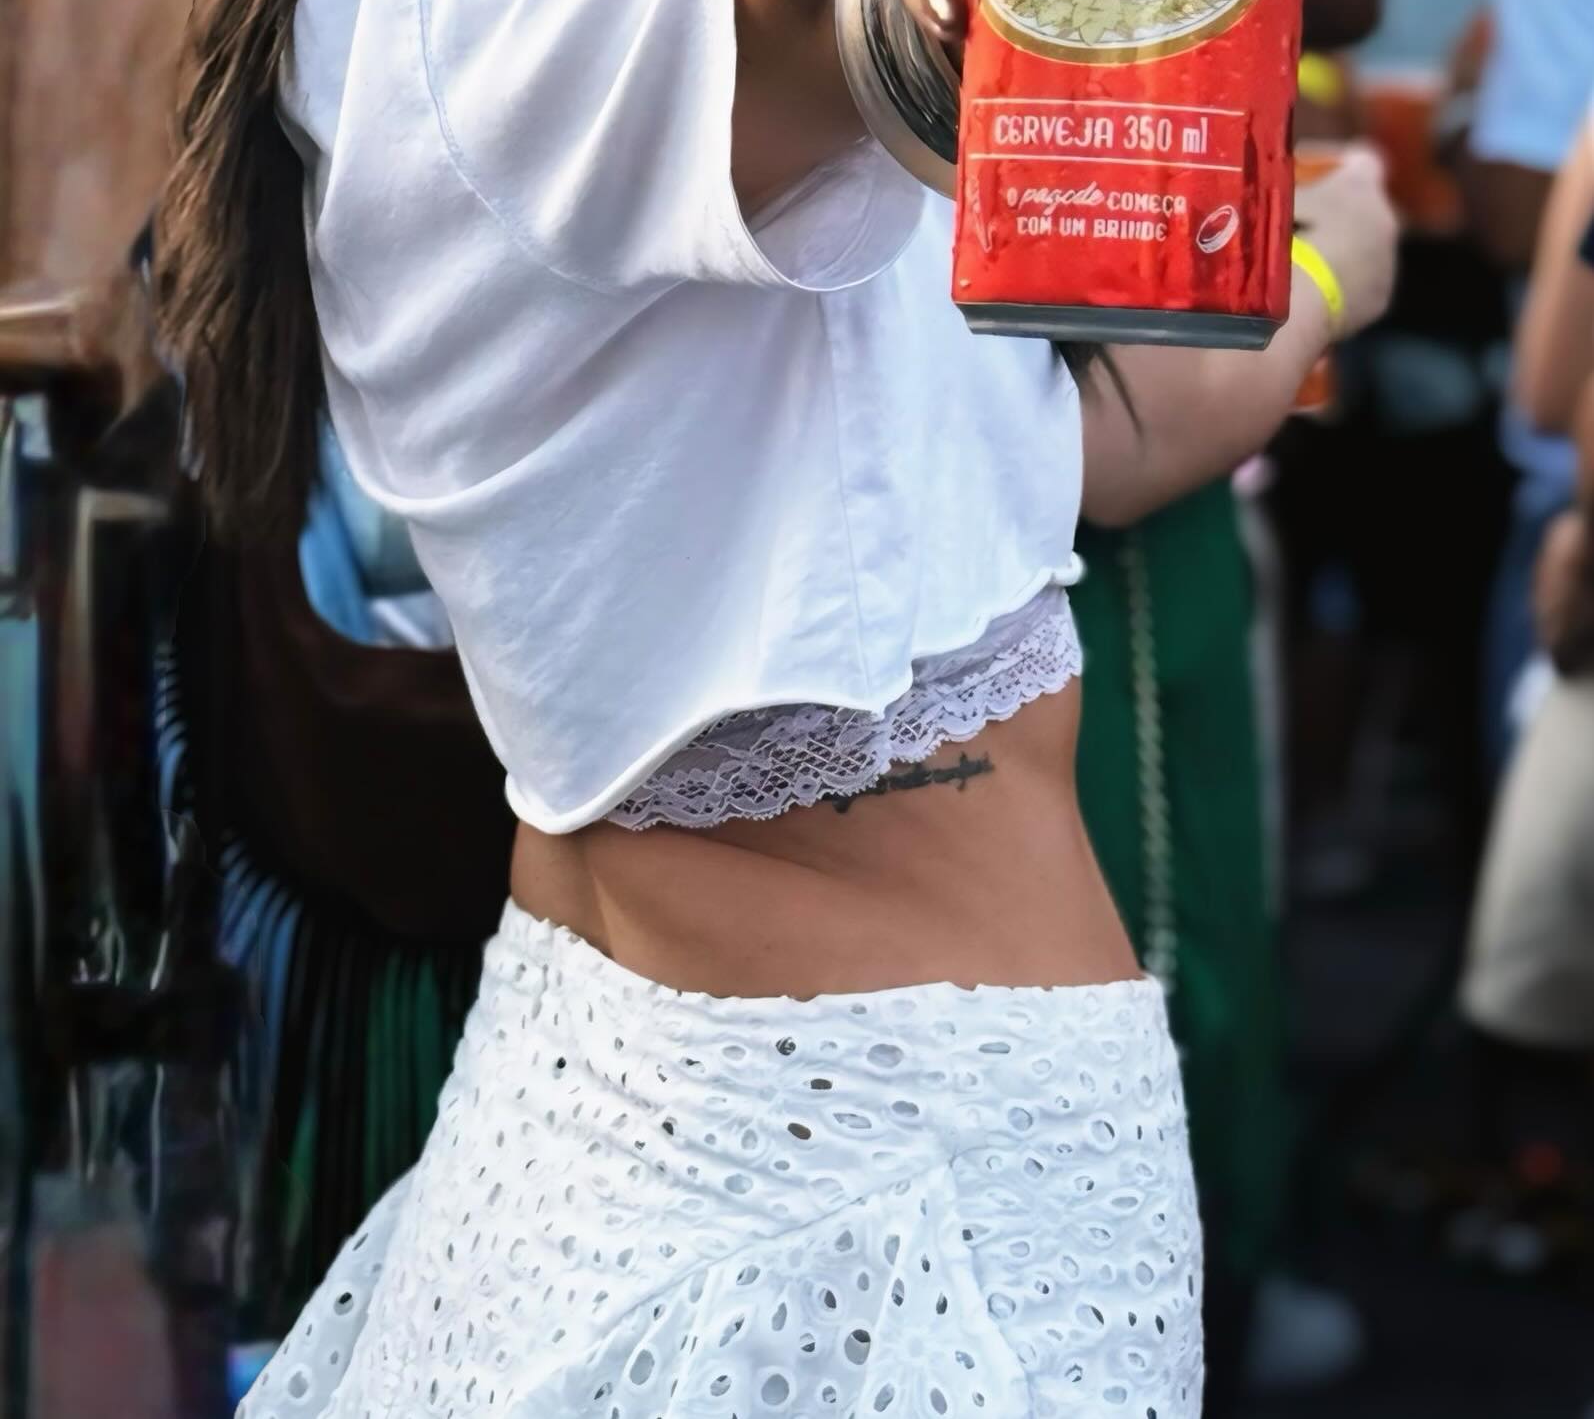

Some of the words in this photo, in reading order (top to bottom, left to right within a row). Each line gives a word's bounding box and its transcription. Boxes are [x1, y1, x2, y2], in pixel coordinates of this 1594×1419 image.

[994, 114, 1114, 149] CERVEJA
[1123, 115, 1173, 152] 350
[1182, 117, 1208, 154] ml
[1018, 181, 1105, 215] pagode
[1106, 191, 1188, 218] COMEÇA
[1016, 216, 1052, 236] COM
[1059, 217, 1086, 237] UM
[1093, 218, 1168, 242] BRINDE
